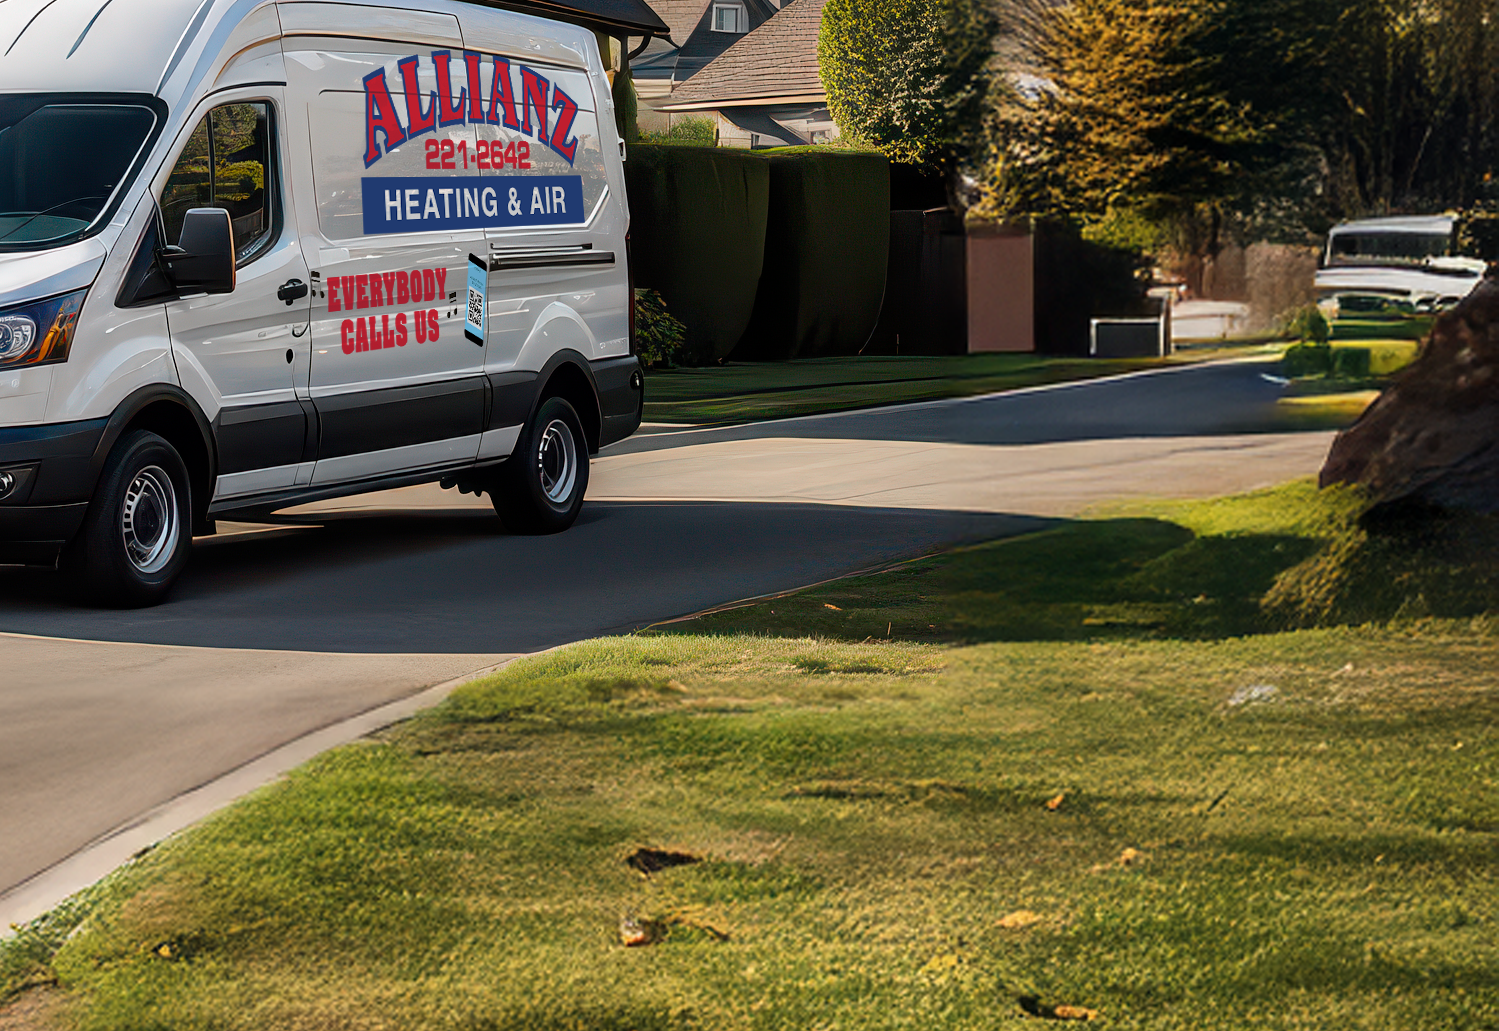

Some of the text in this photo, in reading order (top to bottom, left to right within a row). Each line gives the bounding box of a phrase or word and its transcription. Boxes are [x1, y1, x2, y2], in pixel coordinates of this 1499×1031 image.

[362, 50, 579, 170] ALLIANZ
[424, 138, 532, 169] 221-2642
[384, 185, 567, 221] HEATING & AIR
[326, 267, 447, 313] EVERYBODY
[340, 309, 440, 355] CALLS US
